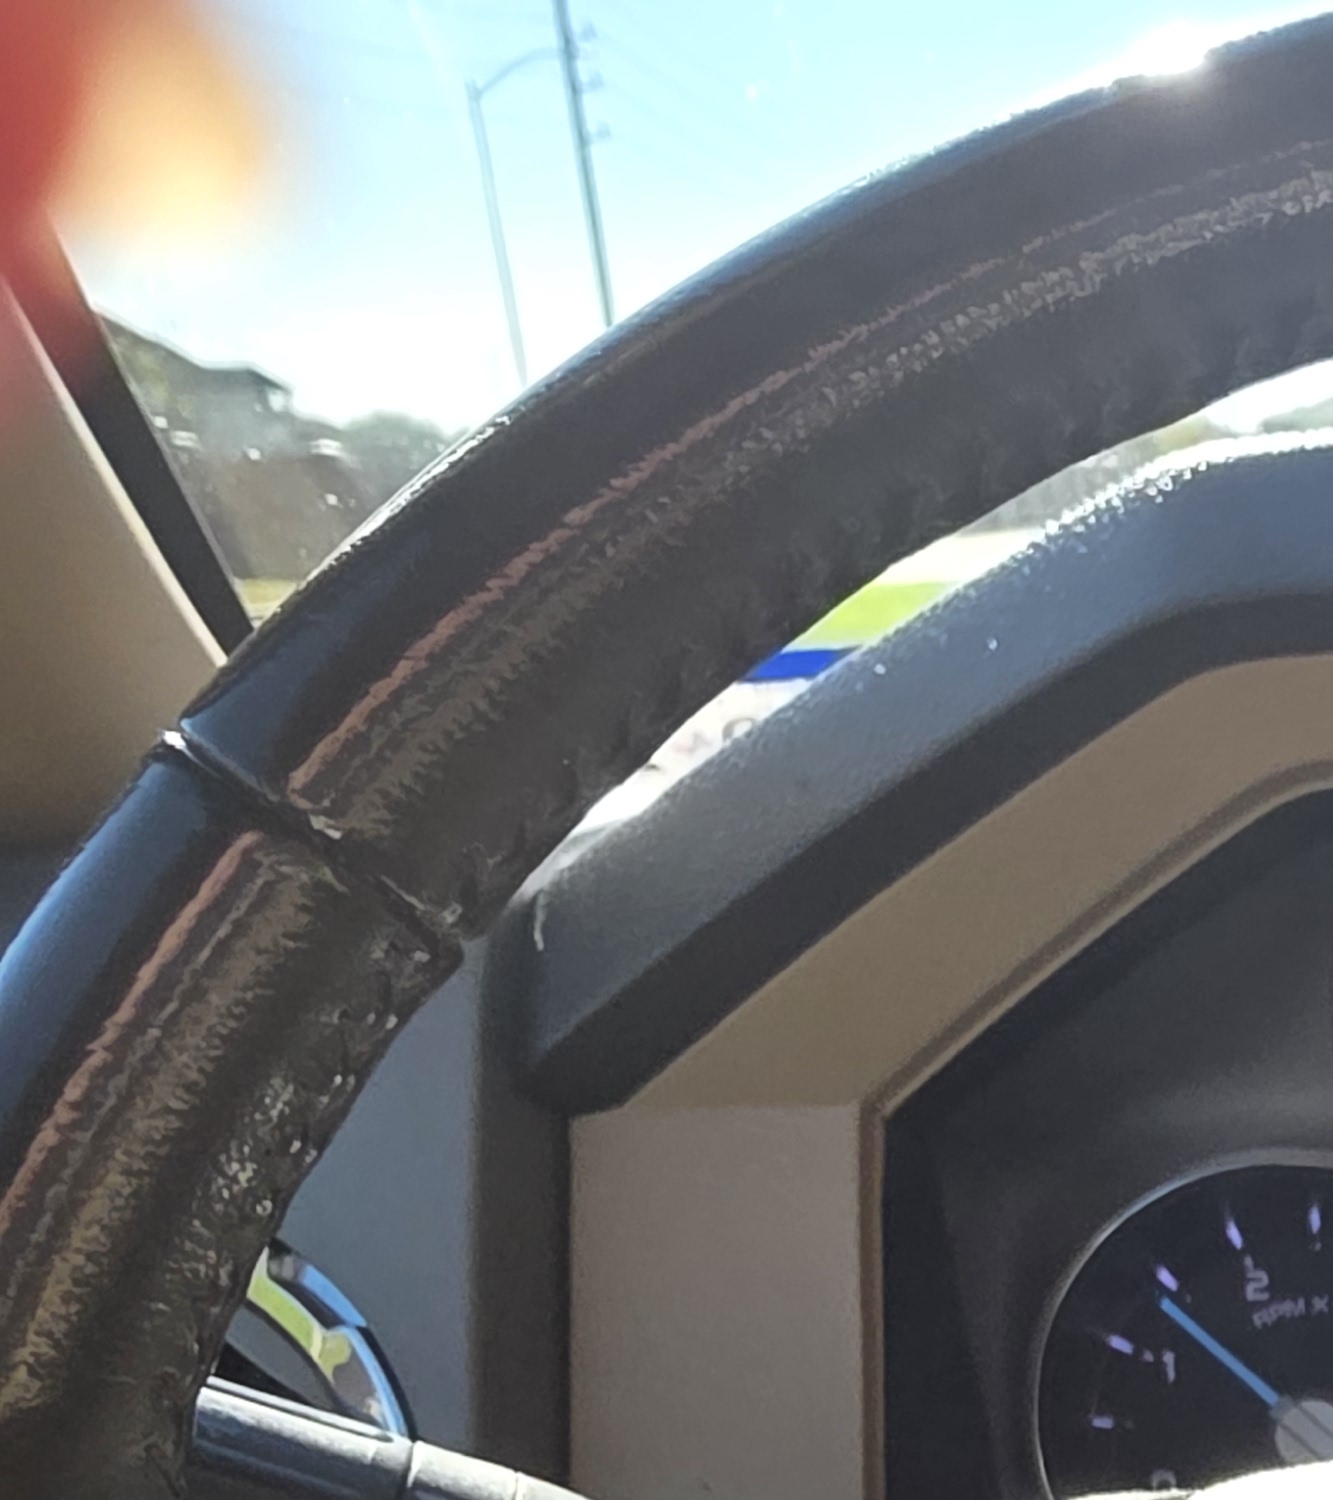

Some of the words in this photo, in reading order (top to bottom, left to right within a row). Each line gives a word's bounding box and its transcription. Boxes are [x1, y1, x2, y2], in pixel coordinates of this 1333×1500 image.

[1245, 1270, 1270, 1302] 2
[1252, 1298, 1306, 1329] RPM
[1161, 1350, 1176, 1383] 1
